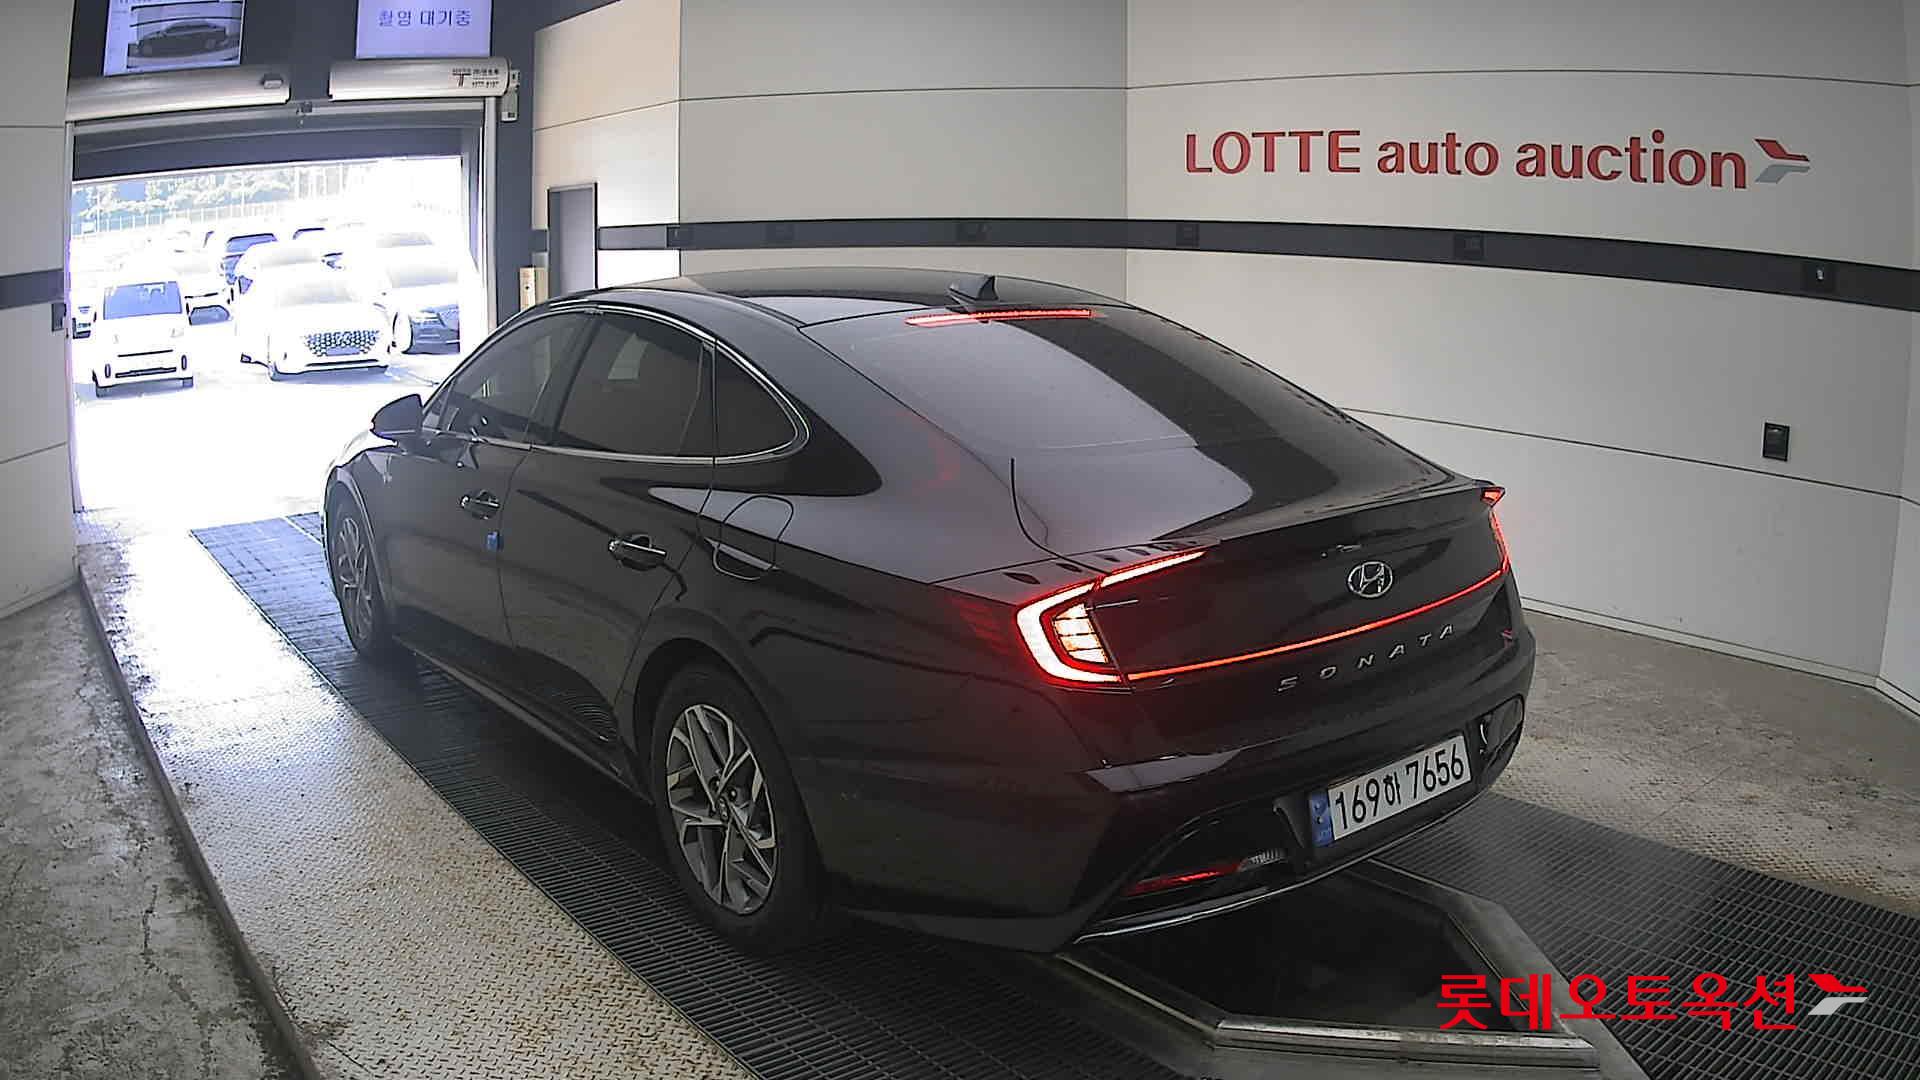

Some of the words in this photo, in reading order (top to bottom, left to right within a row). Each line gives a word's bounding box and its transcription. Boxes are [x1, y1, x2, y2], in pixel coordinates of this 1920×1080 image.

[420, 9, 472, 27] 대기중
[1185, 130, 1361, 175] LOTTE
[1377, 132, 1500, 177] auto
[1515, 129, 1748, 190] auction
[1277, 624, 1454, 692] SONATA
[1334, 776, 1401, 829] 169하
[1405, 743, 1465, 800] 7656
